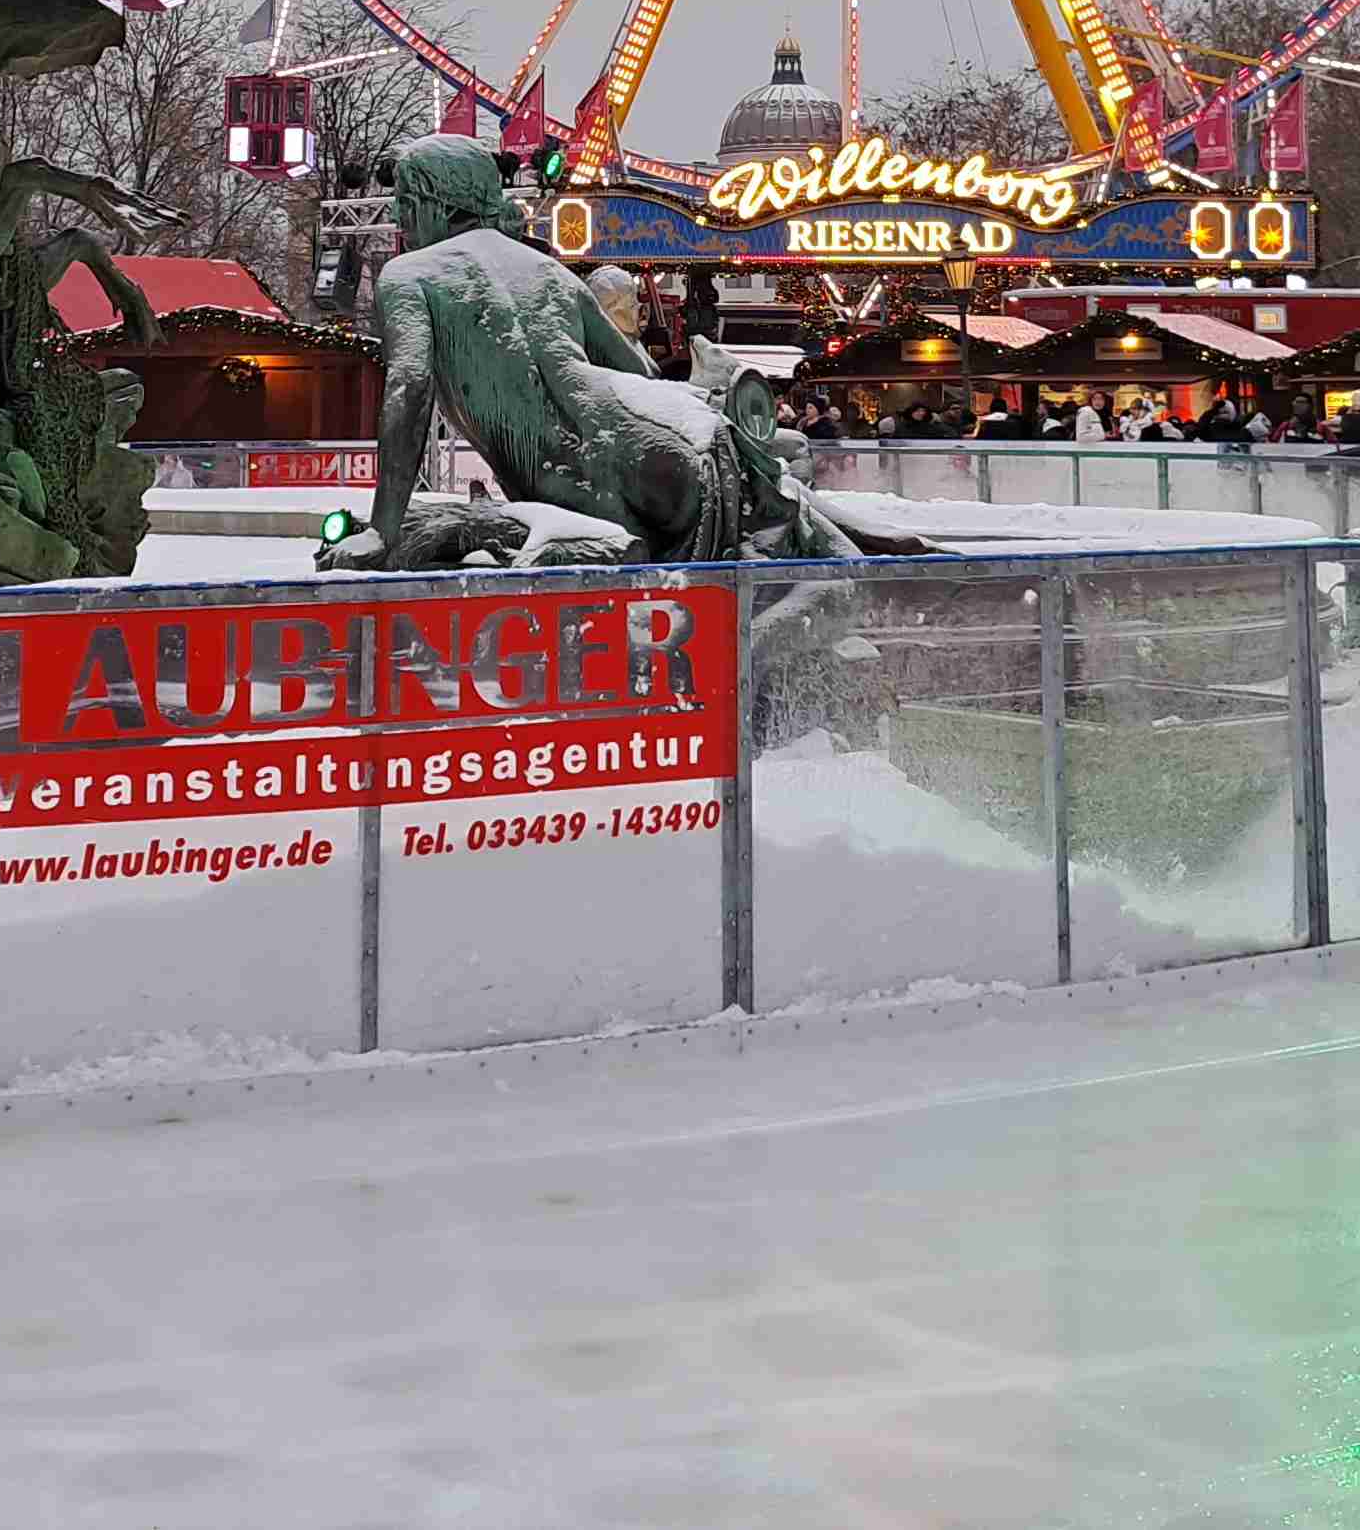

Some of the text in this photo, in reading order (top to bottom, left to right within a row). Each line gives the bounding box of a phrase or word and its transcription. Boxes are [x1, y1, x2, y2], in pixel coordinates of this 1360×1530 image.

[708, 137, 1080, 224] Willenborg
[786, 219, 1014, 254] RIESENRAD
[402, 821, 455, 856] Tel.
